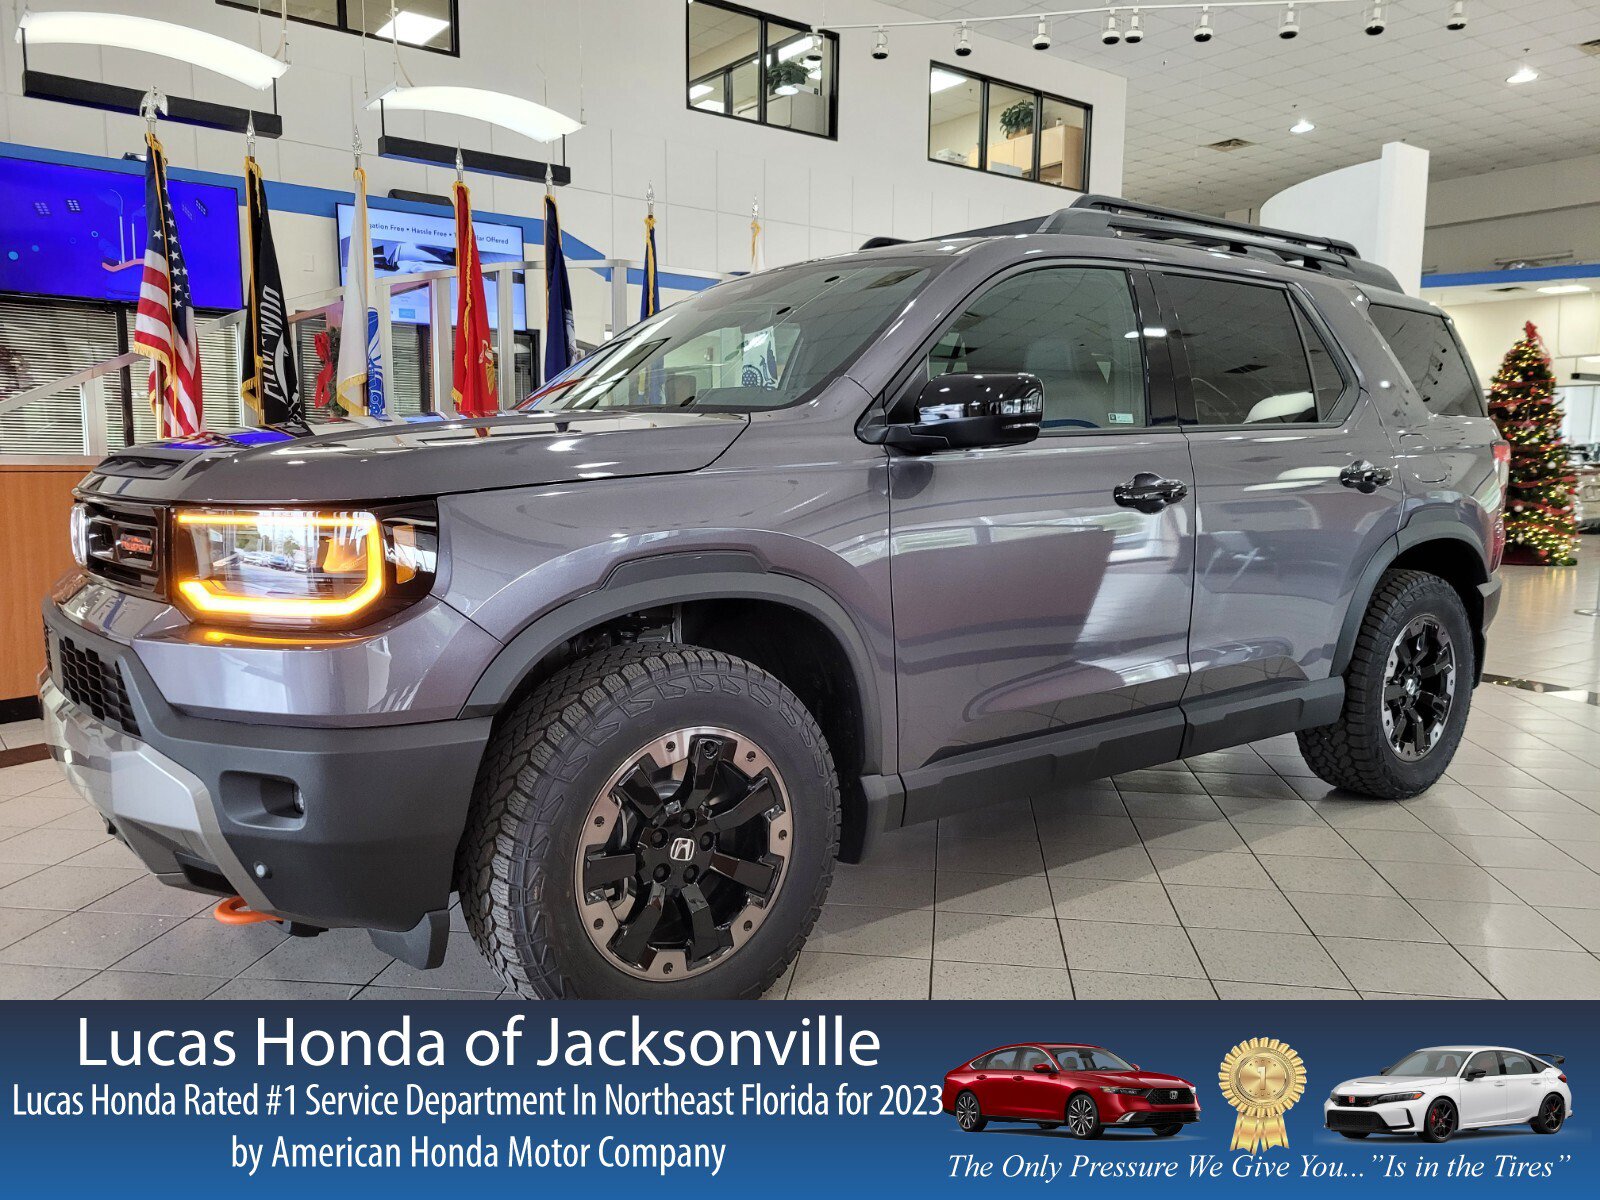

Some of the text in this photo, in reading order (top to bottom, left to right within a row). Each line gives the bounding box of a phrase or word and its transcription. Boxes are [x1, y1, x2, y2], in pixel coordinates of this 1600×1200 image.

[390, 224, 405, 232] Free
[411, 227, 432, 236] Hassle
[433, 230, 448, 238] Free
[485, 236, 509, 245] Offered
